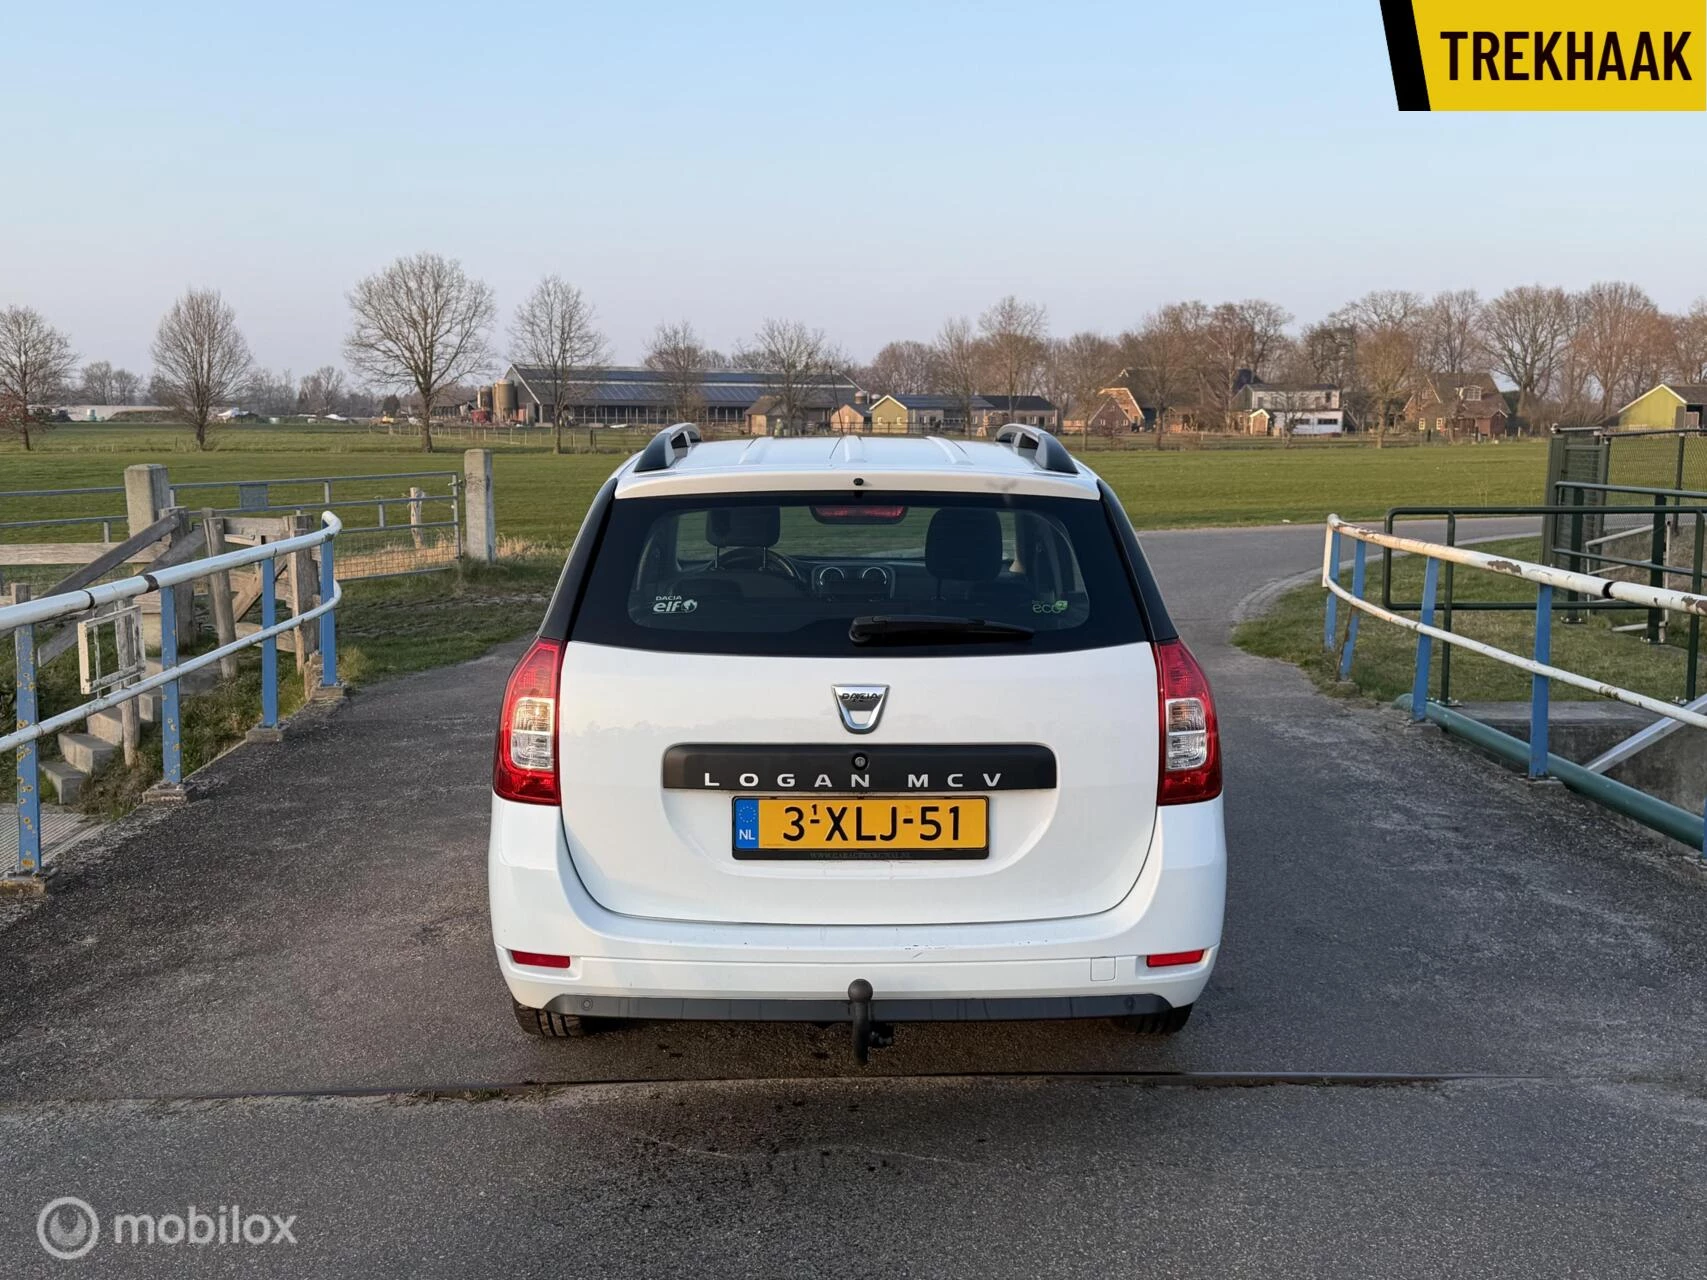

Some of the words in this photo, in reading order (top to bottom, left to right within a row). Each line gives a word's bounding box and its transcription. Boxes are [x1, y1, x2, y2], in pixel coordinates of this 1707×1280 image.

[653, 601, 682, 612] elf
[704, 773, 870, 788] LOGAN
[908, 773, 1002, 788] MCV
[739, 829, 756, 841] NL
